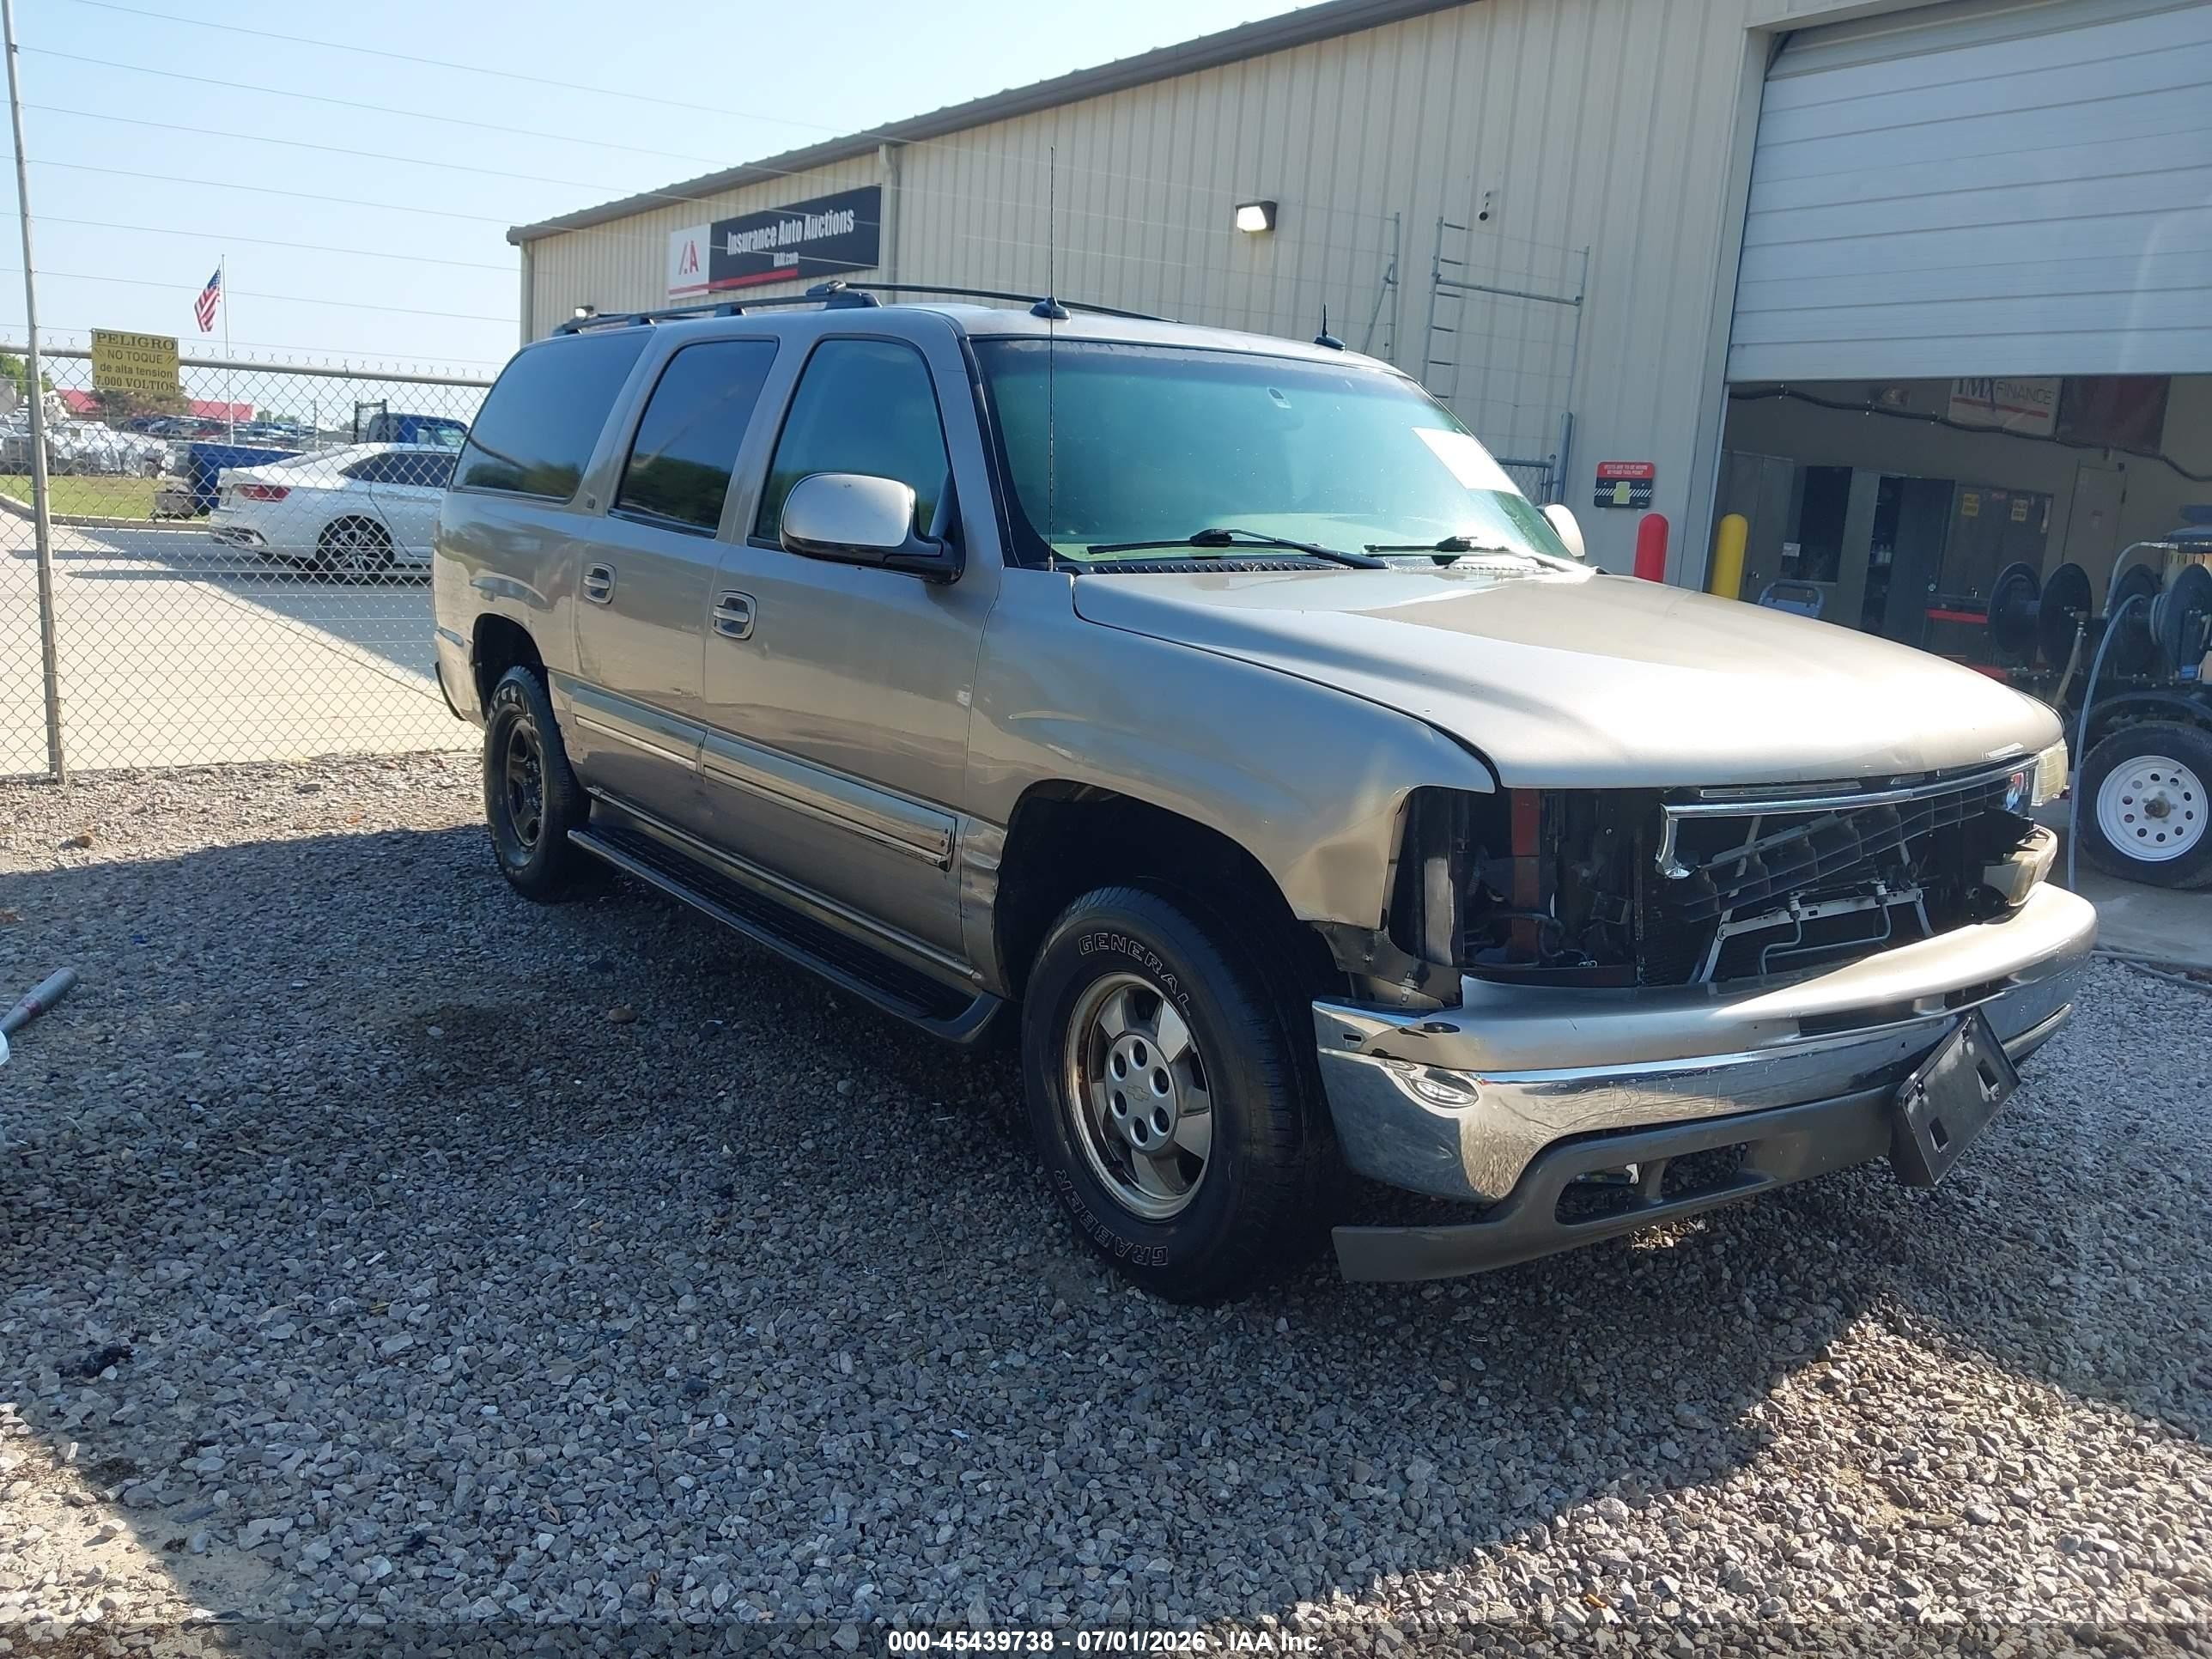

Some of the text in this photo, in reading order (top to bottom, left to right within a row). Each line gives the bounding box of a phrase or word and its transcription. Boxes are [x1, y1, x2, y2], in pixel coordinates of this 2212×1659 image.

[727, 209, 854, 256] Insurance Auto Auctions
[96, 332, 175, 351] PELIGRO
[107, 349, 163, 364] NO TOQUE
[100, 362, 173, 379] de alta tension
[95, 375, 176, 392] 7.000 VOLTIOS
[1996, 381, 2055, 405] FINANCE
[1079, 932, 1193, 1018] GENERAL
[1054, 1168, 1169, 1267] GRABBER
